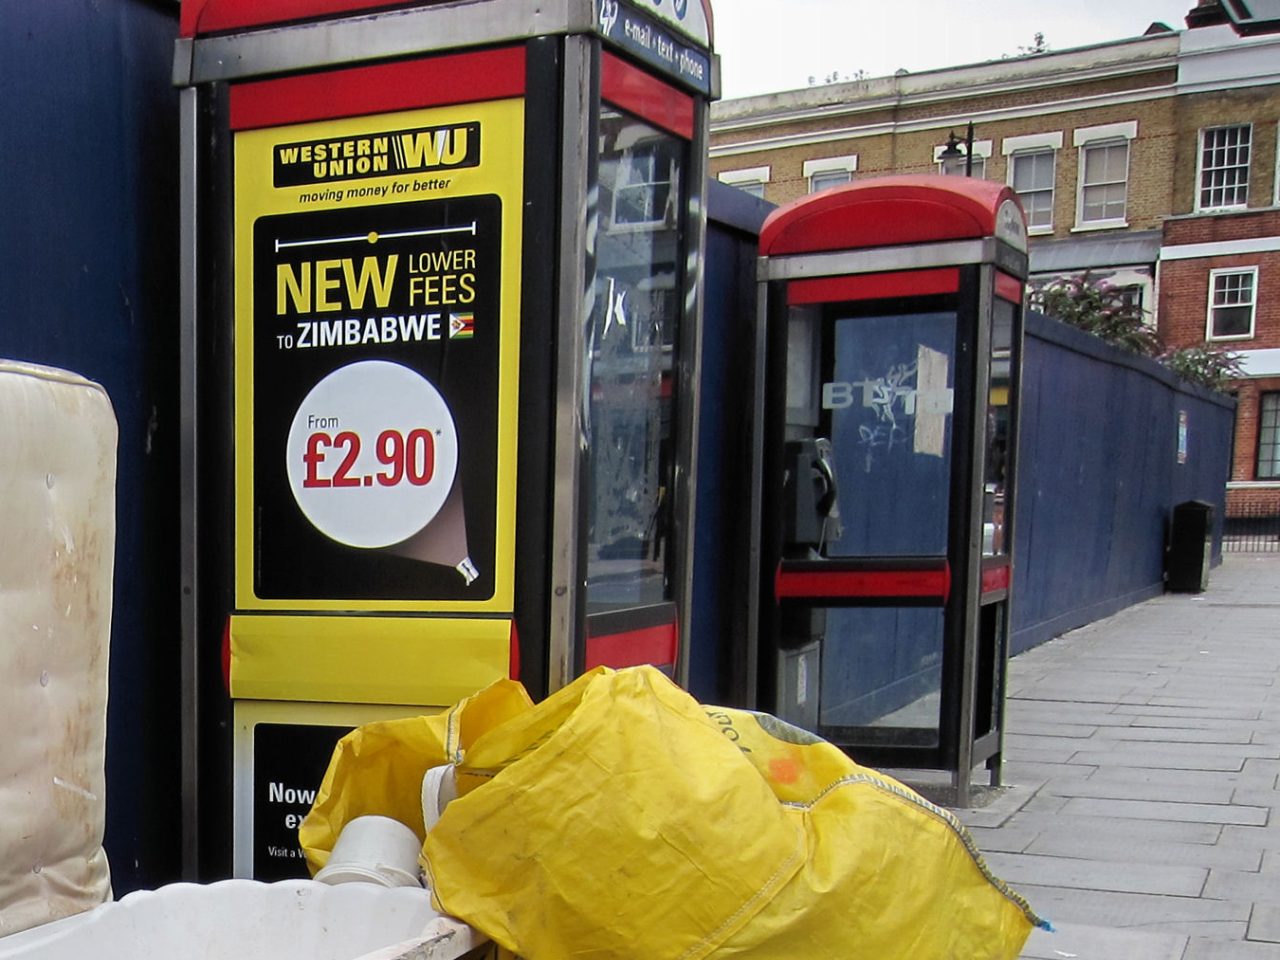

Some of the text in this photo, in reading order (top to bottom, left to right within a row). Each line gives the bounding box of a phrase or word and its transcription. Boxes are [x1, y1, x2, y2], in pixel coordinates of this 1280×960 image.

[624, 18, 703, 81] e-mail text phone
[280, 136, 389, 165] WESTERN
[402, 127, 468, 169] WU
[313, 155, 389, 178] UNION
[299, 178, 451, 203] moving money for better
[409, 249, 476, 274] LOWER
[276, 254, 399, 316] NEW
[409, 272, 476, 307] FEES
[276, 313, 441, 350] TO ZIMBABWE
[307, 414, 339, 430] From
[269, 782, 316, 805] Now
[268, 846, 289, 858] Visit
[290, 849, 296, 858] a
